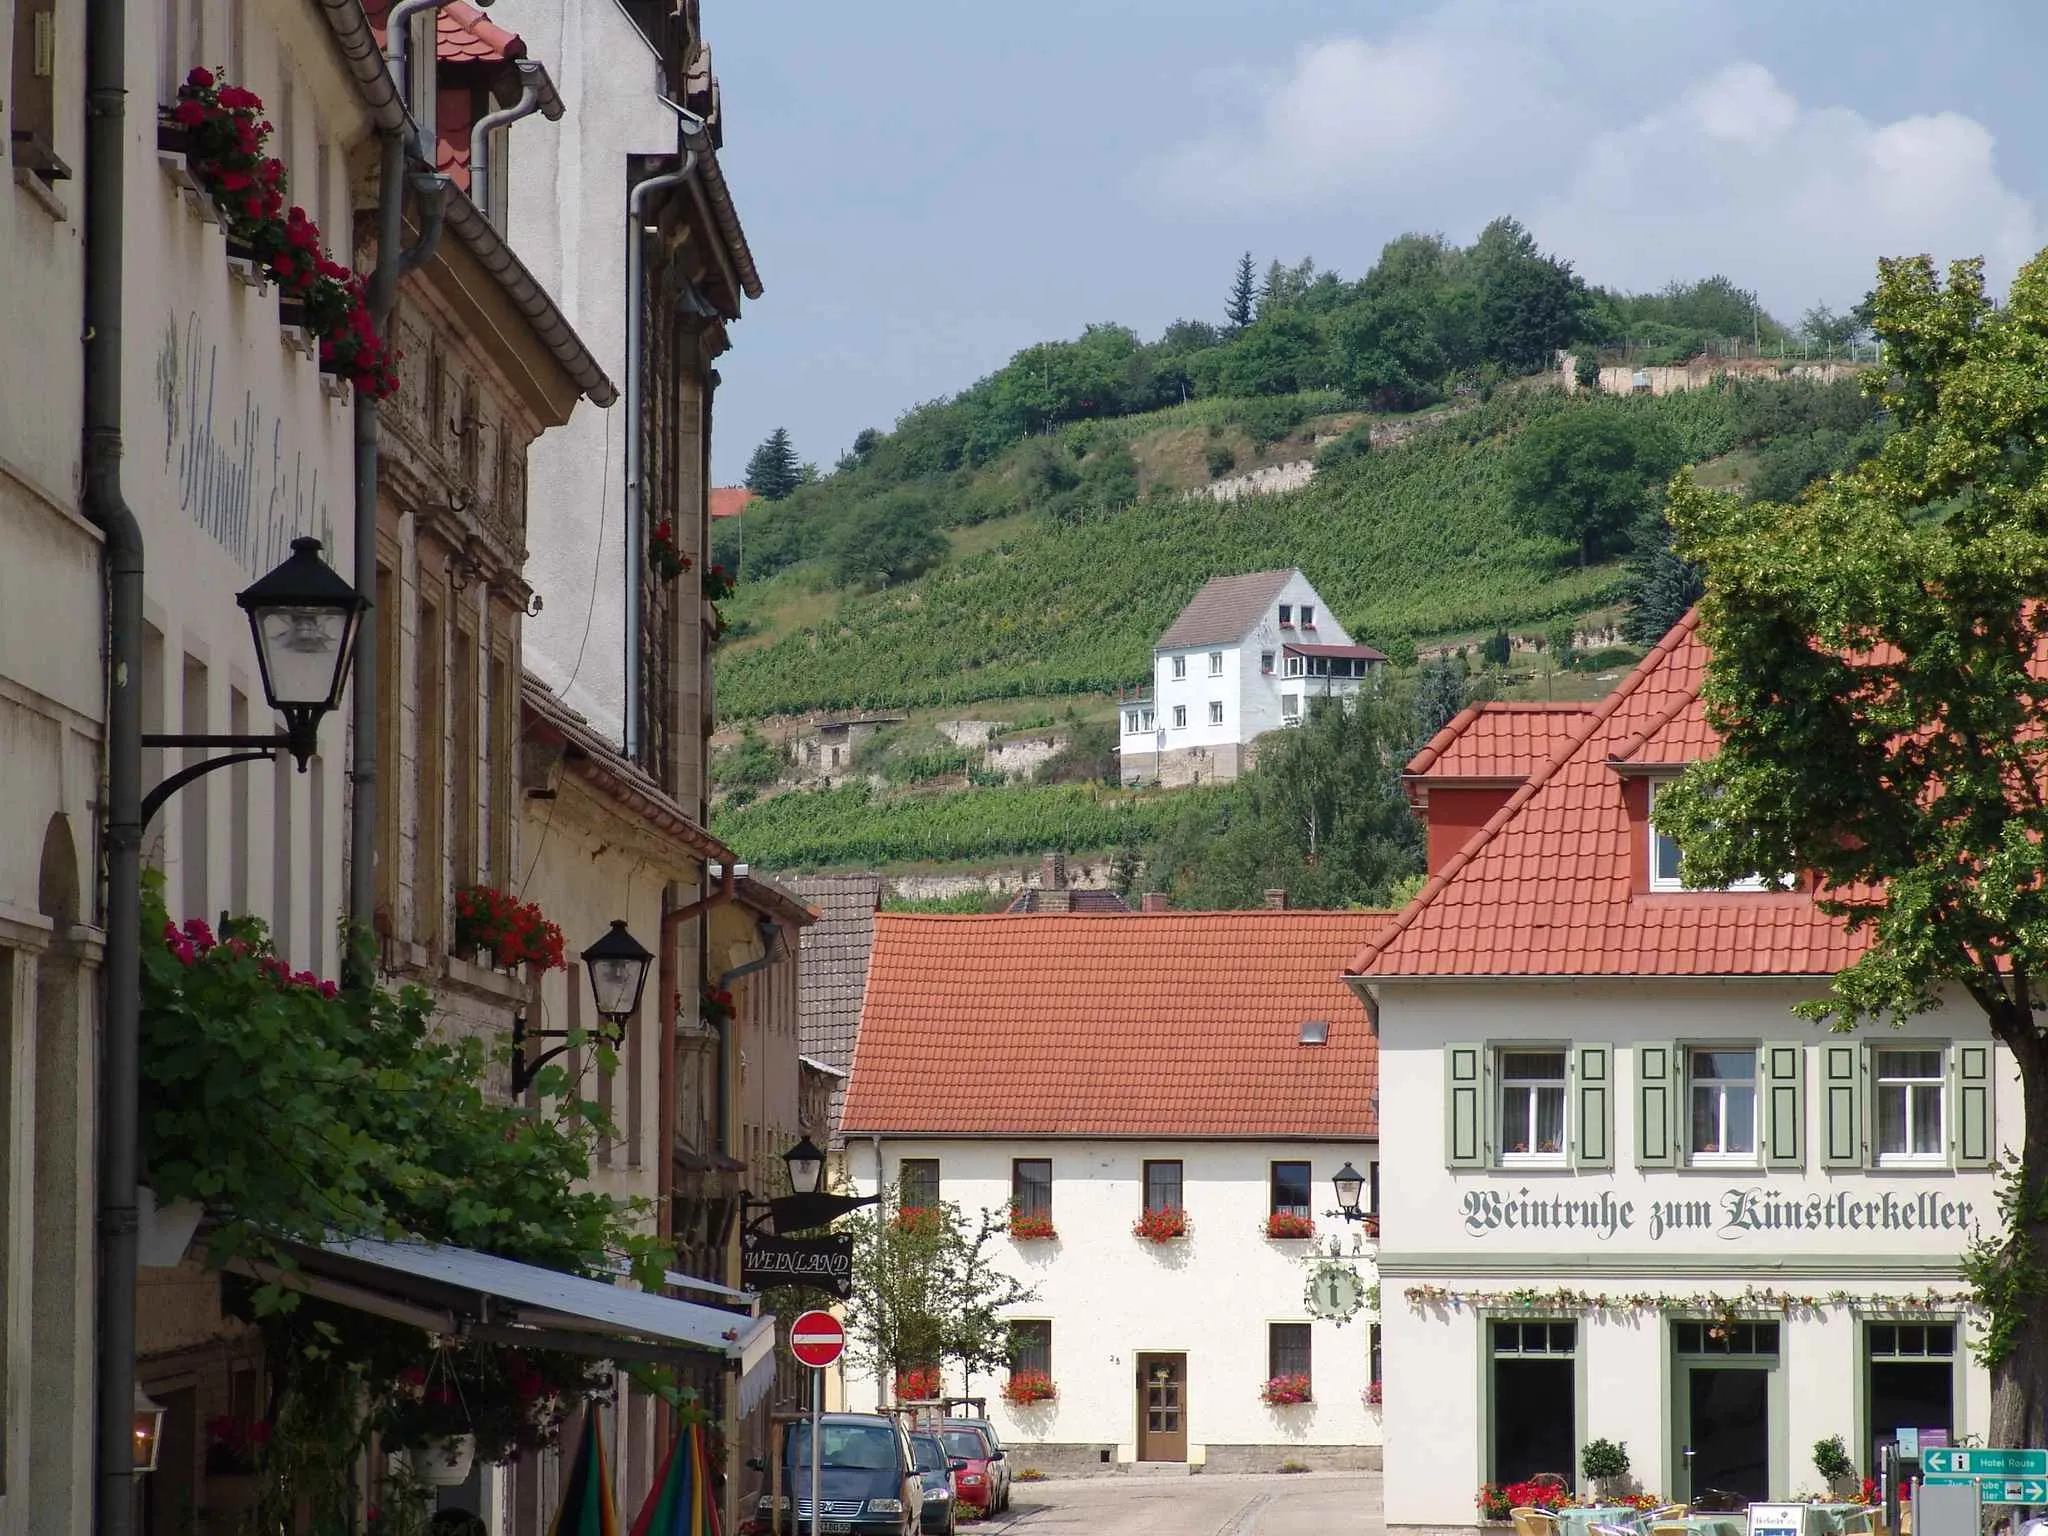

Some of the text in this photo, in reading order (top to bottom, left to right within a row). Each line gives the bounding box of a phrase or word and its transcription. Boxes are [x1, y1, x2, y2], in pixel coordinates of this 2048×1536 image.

[1458, 1187, 1974, 1240] Weintruhe zum Künstlerkeller
[745, 1250, 849, 1275] WEINLAND
[1980, 1457, 2005, 1468] Hotel
[2008, 1458, 2035, 1469] Route
